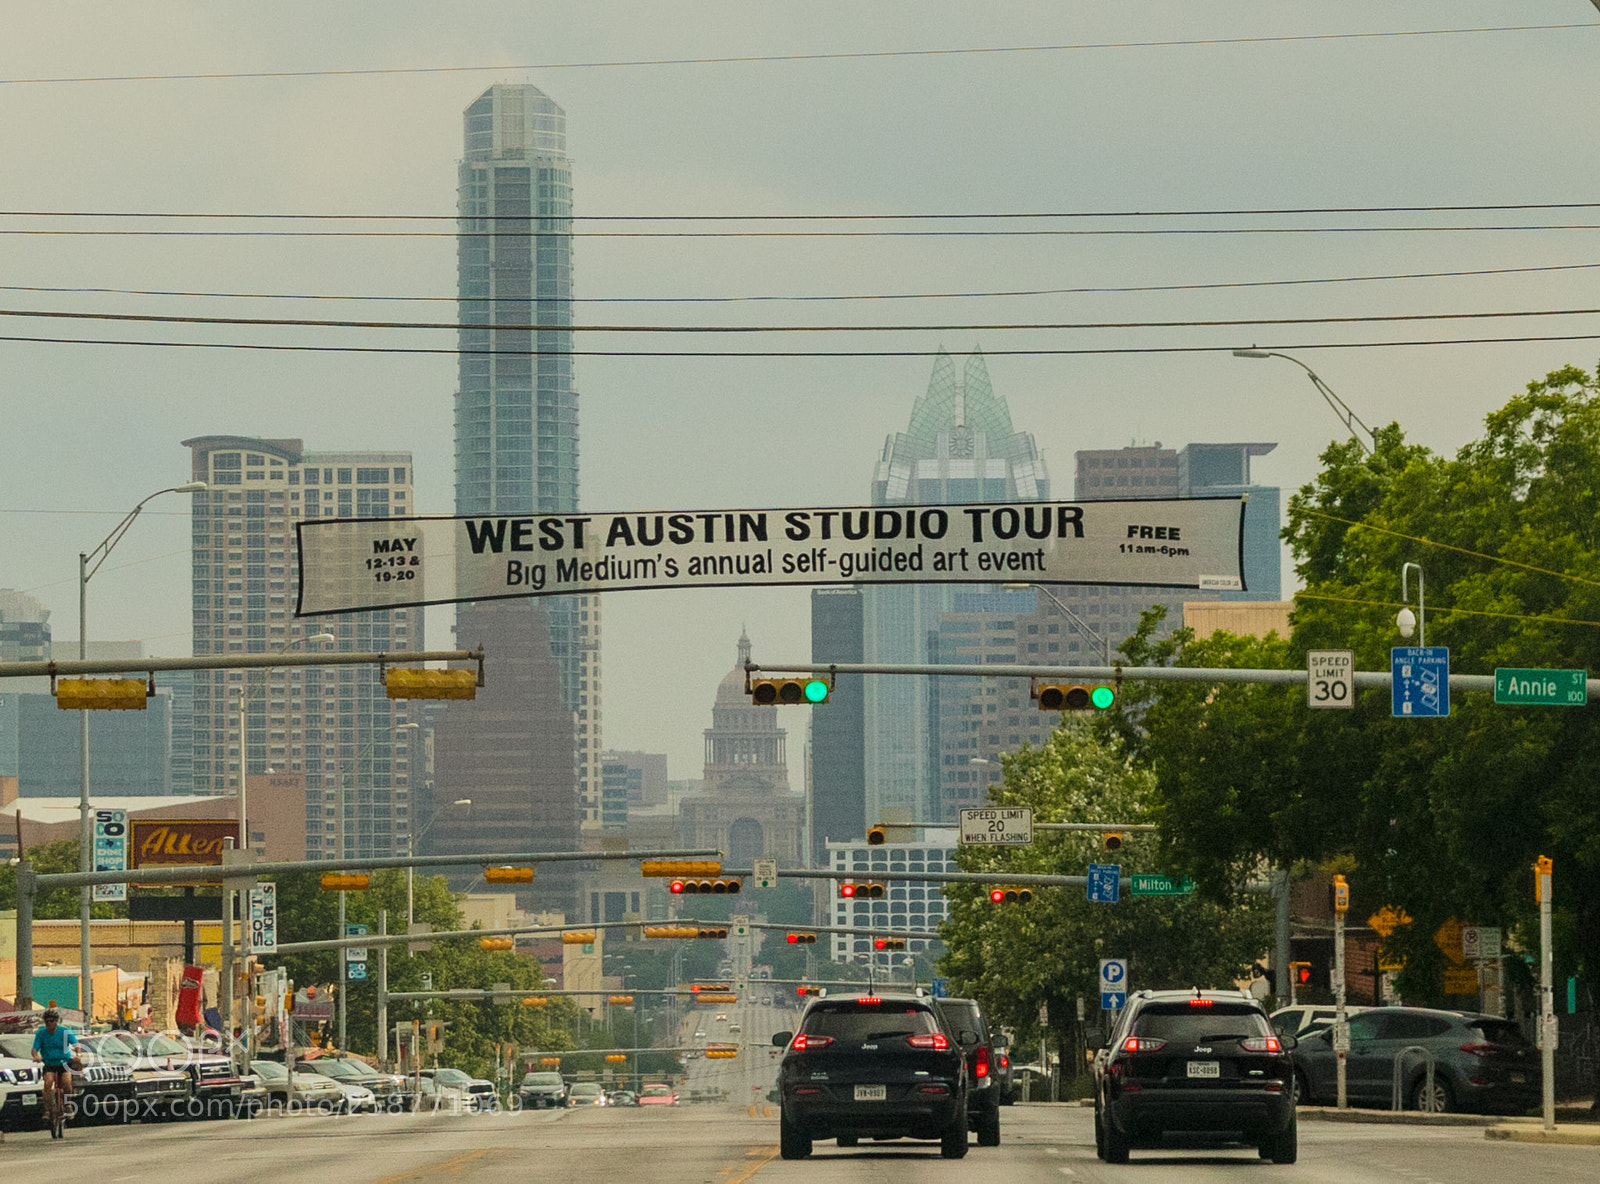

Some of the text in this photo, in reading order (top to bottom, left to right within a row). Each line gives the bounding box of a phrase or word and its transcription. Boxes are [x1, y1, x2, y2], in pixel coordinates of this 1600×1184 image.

[465, 507, 1085, 554] WEST AUSTIN STUDIO TOUR
[1127, 525, 1181, 541] FREE
[373, 538, 417, 554] MAY
[1119, 543, 1190, 557] 11am-6pm
[366, 555, 420, 570] 12-13 &
[506, 544, 1047, 590] Big Medium's annual self-guided art event
[375, 570, 415, 582] 19-20
[1312, 657, 1350, 666] SPEED
[1316, 669, 1344, 678] LIMIT
[1572, 673, 1583, 685] ST
[1315, 680, 1348, 701] 30
[1498, 676, 1556, 697] E Annie
[1568, 691, 1583, 702] 100
[967, 810, 1024, 820] SPEED LIMIT
[988, 820, 1005, 832] 20
[965, 832, 1028, 842] WHEN FLASHING
[97, 857, 122, 865] SHOP
[1139, 879, 1172, 891] Milton
[263, 885, 274, 947] CONGRESS
[1194, 1046, 1212, 1054] Jeep
